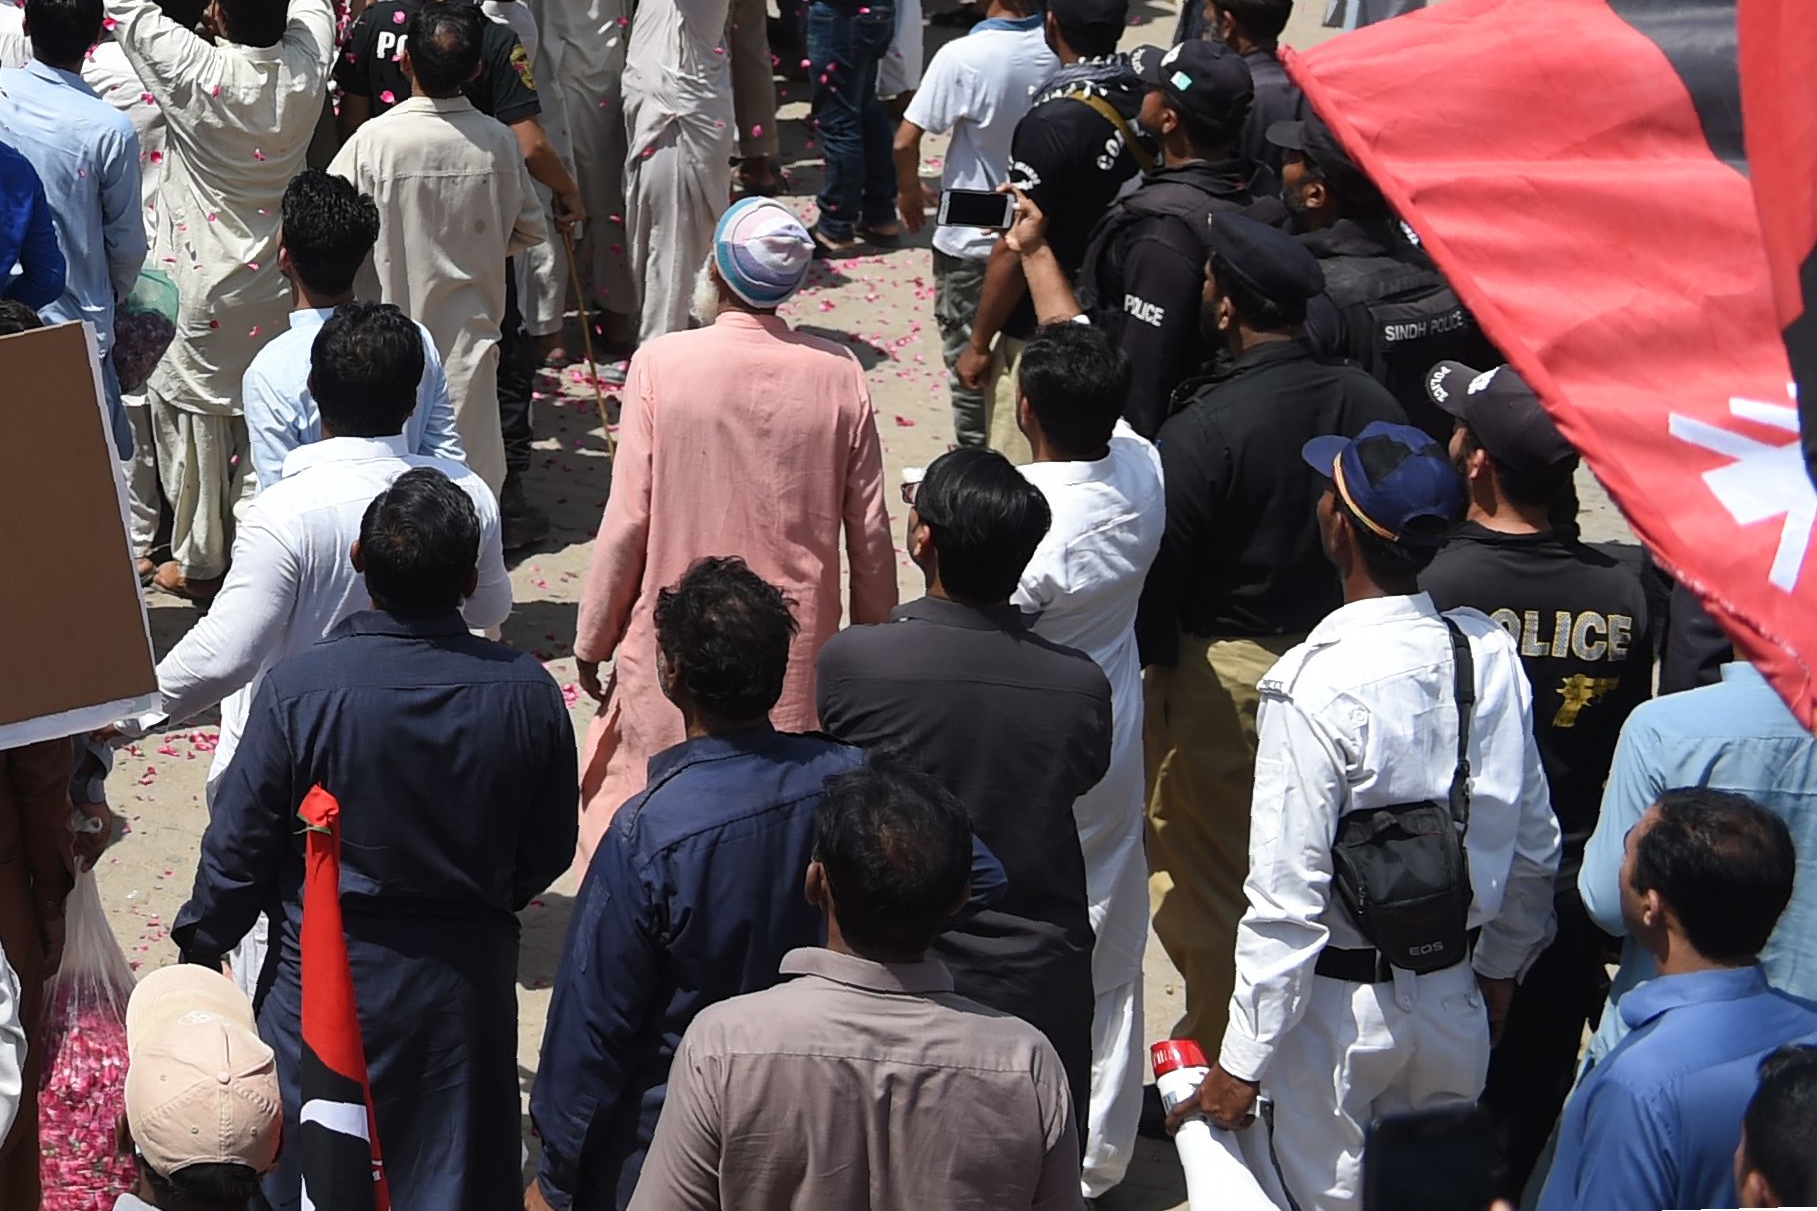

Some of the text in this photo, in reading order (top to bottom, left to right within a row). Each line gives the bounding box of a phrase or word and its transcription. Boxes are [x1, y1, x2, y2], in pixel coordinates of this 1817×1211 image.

[1124, 293, 1165, 327] POLICE
[1385, 310, 1464, 342] SINDH POLICE
[1489, 607, 1633, 663] OLICE
[1408, 941, 1444, 956] EOS
